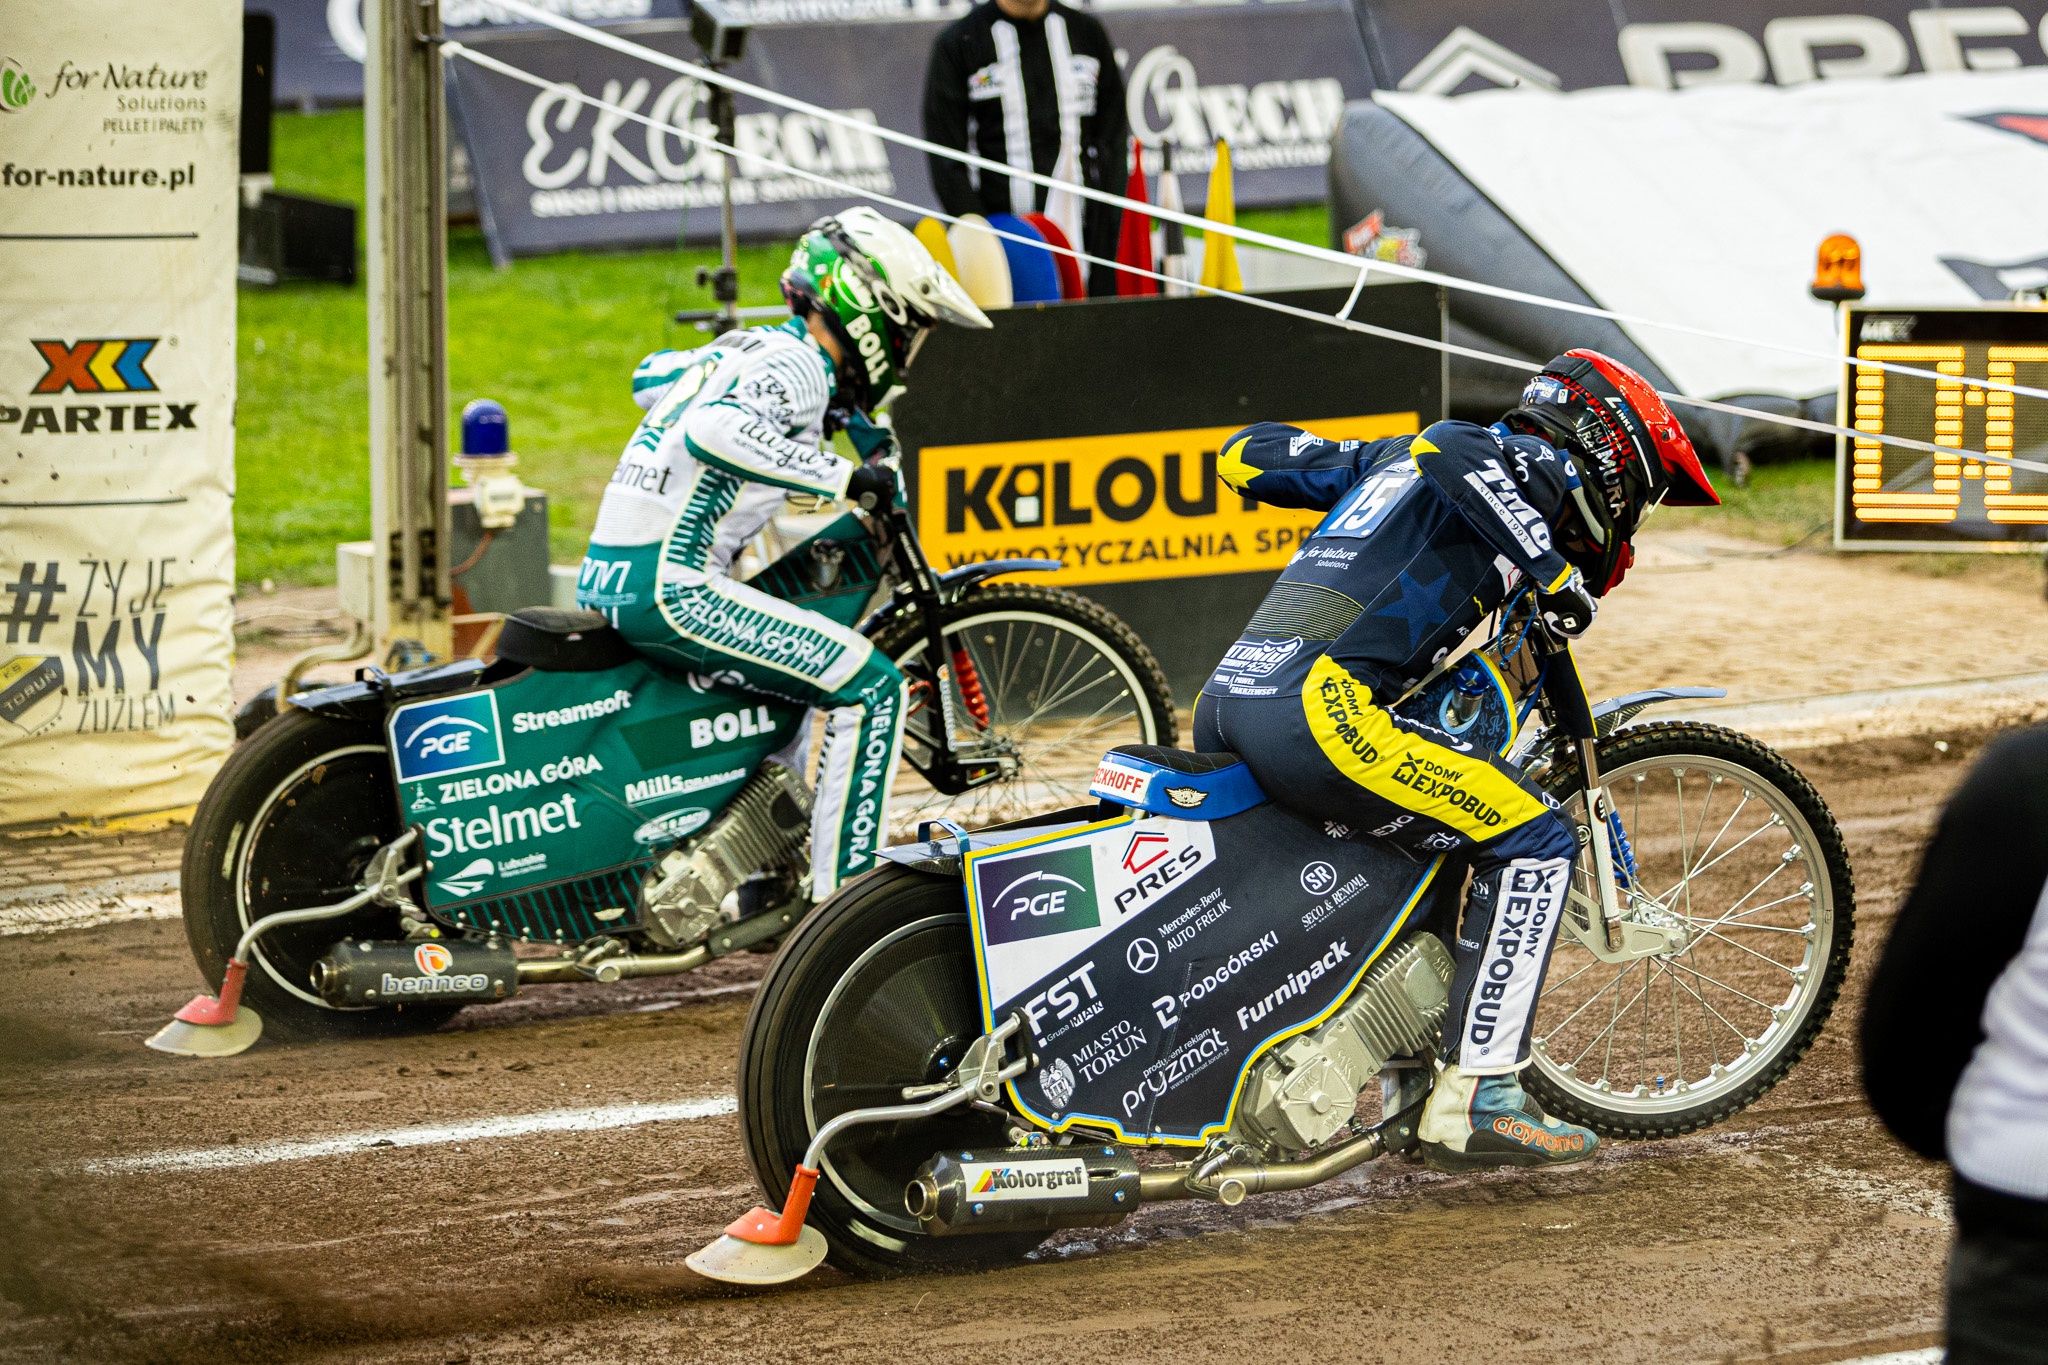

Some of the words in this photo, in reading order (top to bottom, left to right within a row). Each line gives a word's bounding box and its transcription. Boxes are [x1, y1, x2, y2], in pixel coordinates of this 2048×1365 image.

[1615, 8, 2048, 92] PRE
[45, 60, 100, 97] for
[102, 61, 209, 91] Nature
[116, 95, 208, 113] Solutions
[1, 162, 196, 191] for-nature.pl
[845, 313, 890, 385] BOLL
[0, 402, 199, 434] PARTEX
[945, 446, 1260, 534] KILOU
[1328, 477, 1409, 531] 15
[1315, 559, 1350, 570] Solutions
[72, 612, 165, 697] MY
[760, 630, 828, 669] GÓRA
[512, 689, 632, 733] Streamsoft
[690, 705, 776, 749] BOLL
[420, 730, 472, 759] PGE
[438, 769, 540, 804] ZIELONA
[540, 753, 604, 784] GÓRA
[624, 774, 684, 804] Mills
[1424, 760, 1464, 782] DOMY
[426, 792, 582, 858] Stelmet
[1410, 773, 1502, 827] EXPOBUD
[846, 798, 877, 870] GÓRA
[1113, 844, 1202, 915] PRES
[1301, 905, 1325, 928] SECO
[1331, 873, 1367, 905] RENOMA
[1305, 865, 1332, 890] SR
[1010, 890, 1067, 921] PGE
[1157, 886, 1223, 938] Mercedes-Benz
[1166, 925, 1196, 953] AUTO
[1194, 898, 1232, 931] FRELIK
[1523, 898, 1551, 959] DOMY
[381, 973, 489, 996] bennco
[1178, 930, 1280, 1009] PODGÓRSKI
[1236, 938, 1352, 1032] Furnipack
[1470, 895, 1533, 1046] EXPOBUD
[1024, 960, 1098, 1036] FST
[1046, 1024, 1070, 1042] Grupa
[1071, 1019, 1131, 1067] MIASTO
[1078, 1025, 1148, 1083] TORUŃ
[1183, 1028, 1211, 1049] reklam
[1122, 1027, 1228, 1118] pryzmat
[1492, 1115, 1585, 1152] daytona
[993, 1166, 1082, 1190] Kolorgraf
